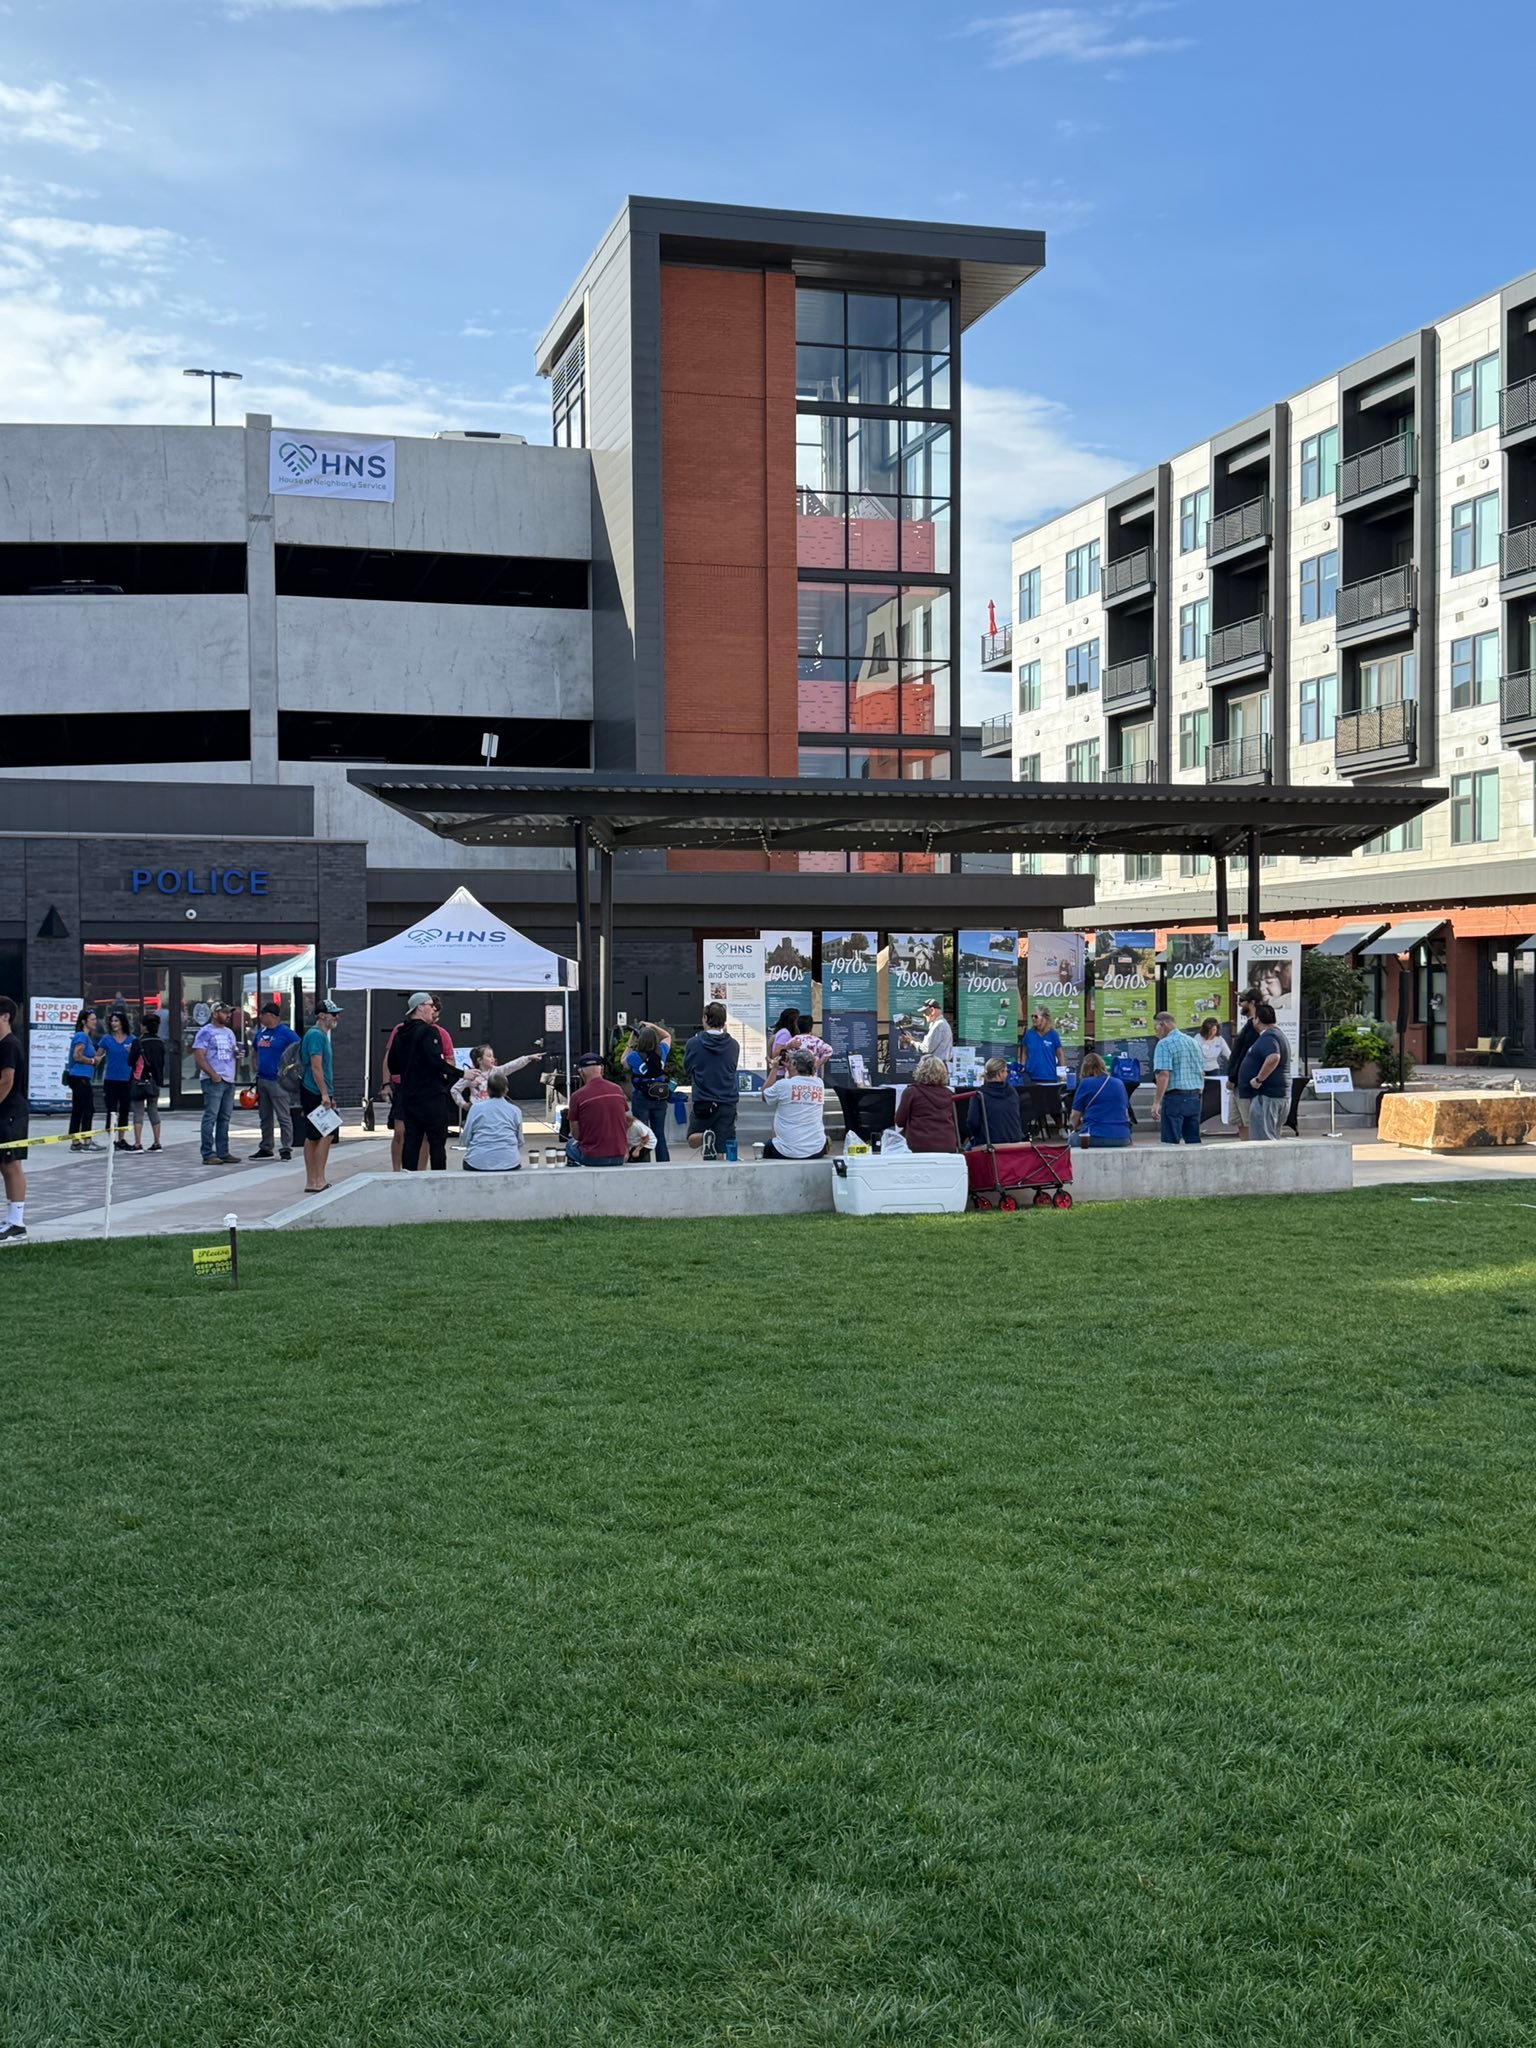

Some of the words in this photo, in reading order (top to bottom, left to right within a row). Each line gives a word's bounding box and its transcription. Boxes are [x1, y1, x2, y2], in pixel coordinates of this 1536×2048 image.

[321, 453, 386, 479] HNS
[279, 475, 304, 485] House
[304, 477, 313, 485] of
[313, 478, 357, 489] Neighborly
[357, 481, 387, 490] Service
[131, 867, 269, 896] POLICE
[445, 930, 506, 943] HNS
[730, 944, 753, 954] HNS
[1265, 945, 1289, 955] HNS
[708, 962, 744, 972] Programs
[768, 964, 805, 981] 1960s
[830, 957, 869, 974] 1970s
[1172, 962, 1223, 980] 2020s
[708, 970, 722, 979] and
[724, 970, 756, 979] Services
[895, 970, 936, 987] 1980s
[1102, 973, 1149, 990] 2010s
[966, 976, 1010, 993] 1990s
[1032, 981, 1080, 998] 2000s
[60, 1003, 78, 1011] FOR
[198, 1249, 230, 1258] Please
